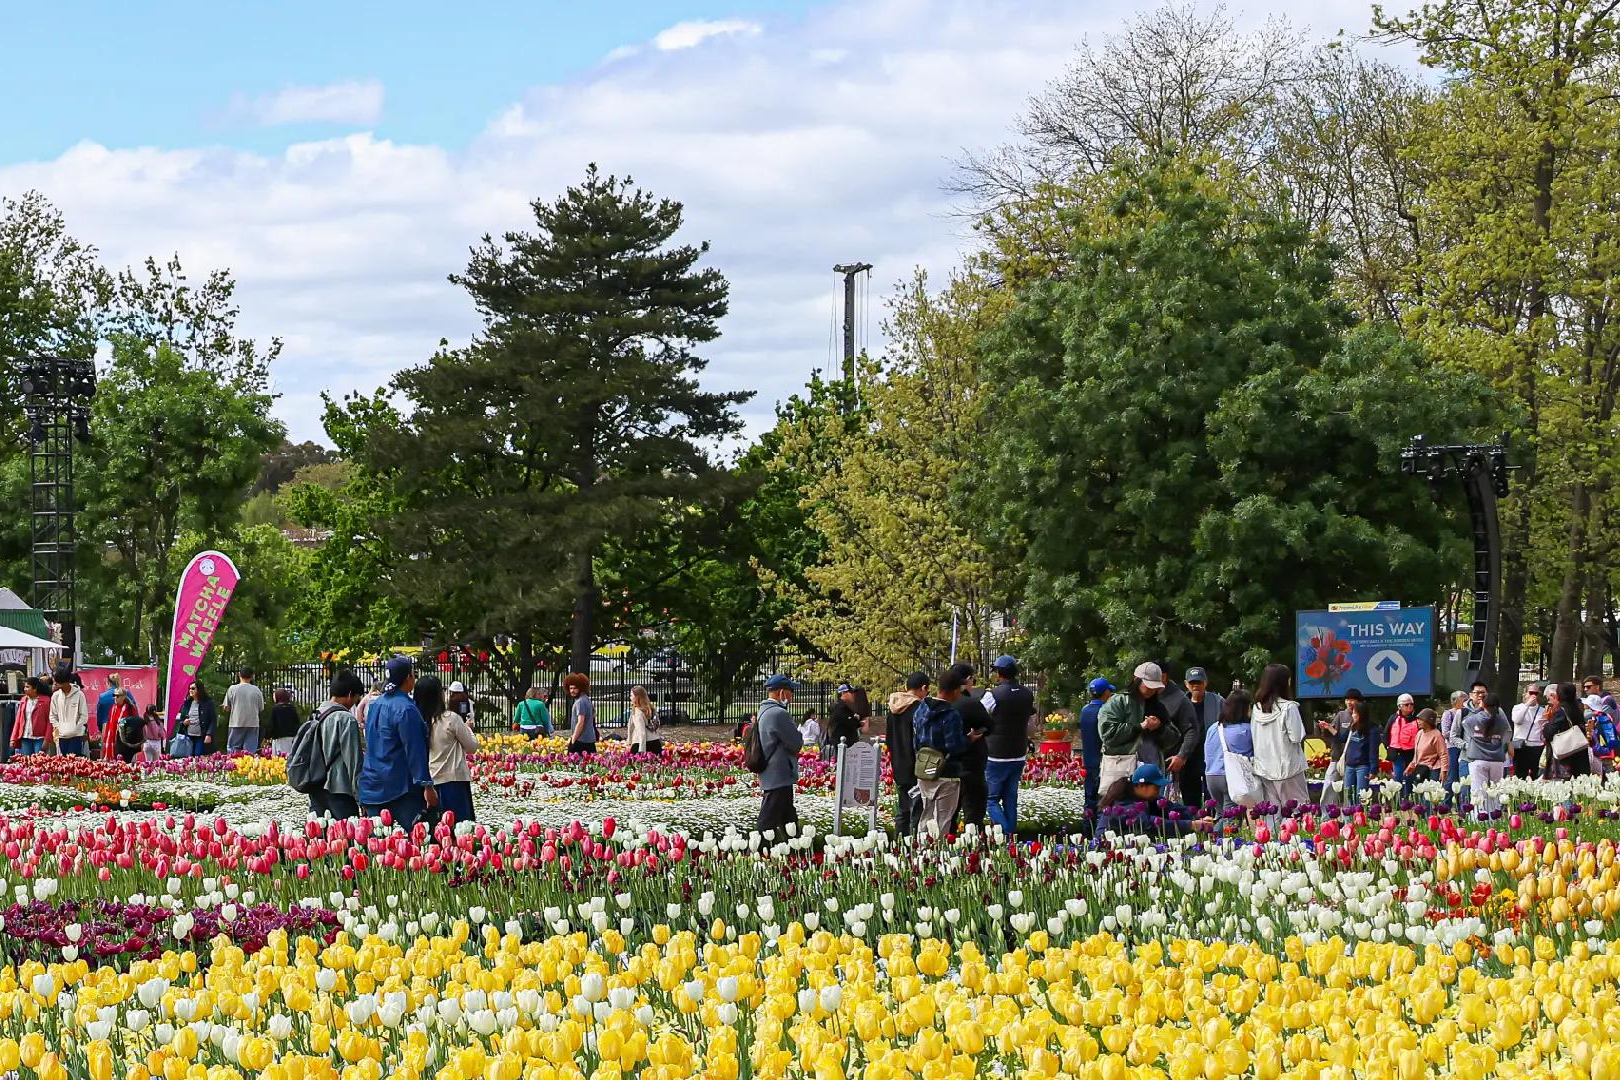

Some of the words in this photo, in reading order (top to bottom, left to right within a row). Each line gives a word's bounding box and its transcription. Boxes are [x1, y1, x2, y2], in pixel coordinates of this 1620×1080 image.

[178, 575, 221, 649] MATCHA
[190, 586, 231, 658] WAFFLE
[1348, 623, 1385, 637] THIS
[1389, 622, 1425, 636] WAY
